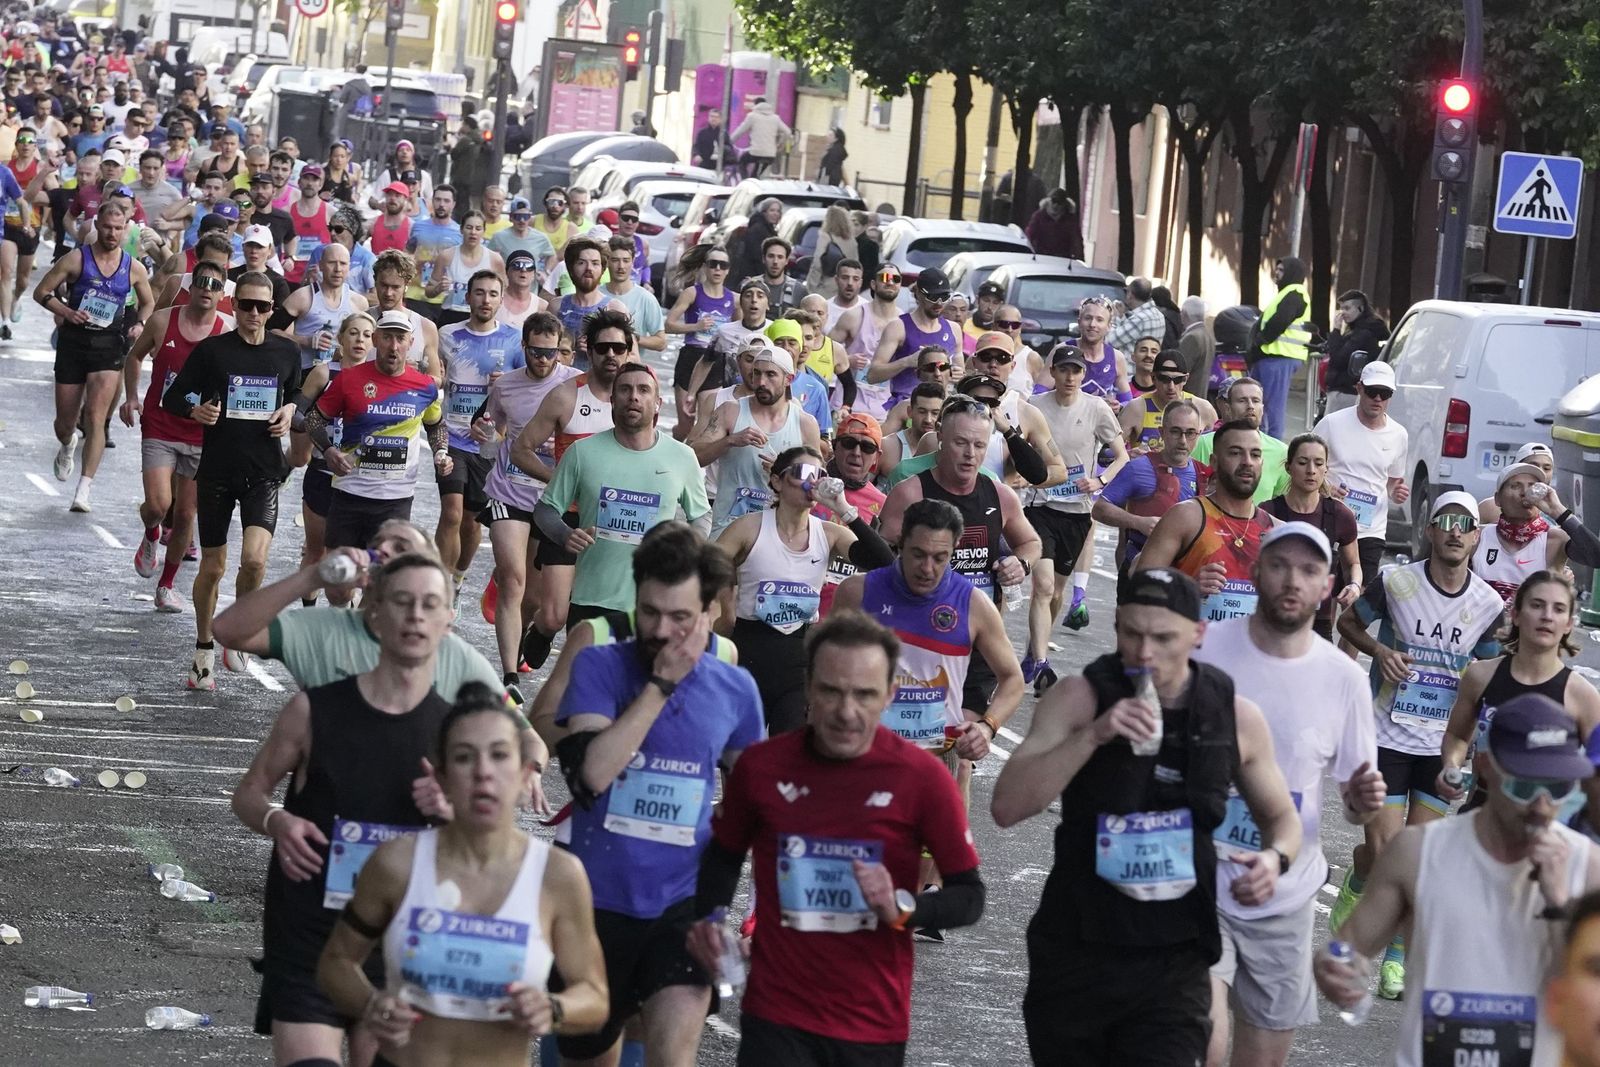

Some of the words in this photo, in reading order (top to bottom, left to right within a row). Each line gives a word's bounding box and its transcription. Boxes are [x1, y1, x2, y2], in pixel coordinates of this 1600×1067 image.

[236, 399, 268, 410] PIERRE
[367, 404, 416, 417] PALACIEGO
[377, 450, 392, 458] 5160
[360, 461, 383, 470] AMODEO
[620, 493, 654, 504] ZURICH
[751, 491, 773, 500] ZURIC
[1351, 491, 1374, 502] ZURICH
[619, 508, 638, 518] 7364
[607, 518, 646, 532] JULIEN
[779, 584, 813, 594] ZURICH
[1224, 582, 1256, 593] ZURICH
[1415, 619, 1462, 645] LAR
[1423, 675, 1457, 687] ZURICH
[1394, 701, 1418, 714] ALEX
[901, 710, 922, 720] 6577
[650, 757, 701, 774] ZURICH
[634, 799, 682, 821] RORY
[1132, 814, 1181, 830] ZURICH
[813, 842, 869, 858] ZURICH
[1120, 860, 1175, 879] JAMIE
[804, 888, 852, 908] YAYO
[447, 916, 517, 938] ZURICH
[1460, 998, 1524, 1015] ZURICH
[1454, 1048, 1500, 1067] DAN
